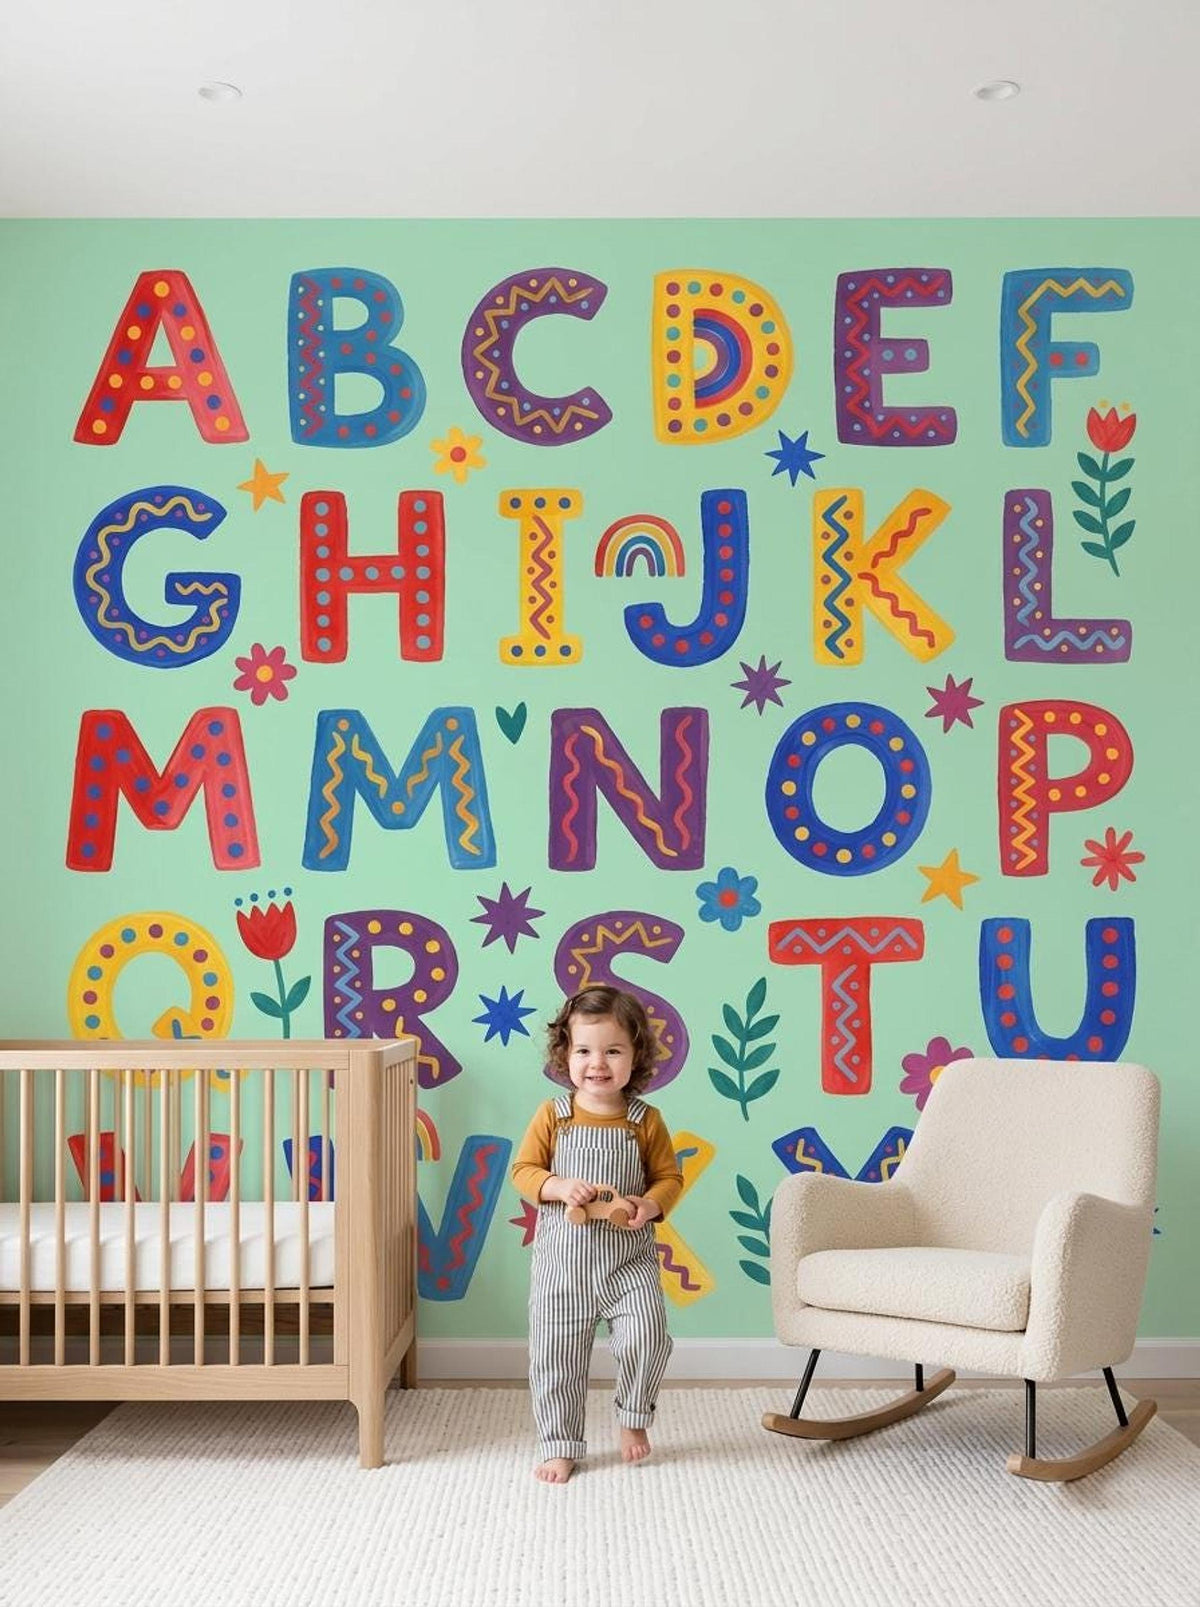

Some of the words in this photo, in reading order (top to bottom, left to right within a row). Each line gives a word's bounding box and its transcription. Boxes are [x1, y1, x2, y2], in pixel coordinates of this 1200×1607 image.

[74, 268, 249, 446] A
[287, 267, 426, 448] B
[461, 267, 613, 446] C
[651, 268, 795, 446] D
[834, 267, 957, 447] E
[1000, 268, 1135, 447] F
[72, 484, 242, 669] G
[299, 489, 446, 664] H
[498, 487, 584, 667] I
[624, 488, 751, 668] J
[812, 487, 955, 667] K
[1003, 488, 1133, 664] L
[65, 706, 261, 873] M
[302, 706, 497, 872] M
[548, 706, 709, 872] N
[765, 701, 932, 877] O
[997, 699, 1135, 877] P
[66, 911, 249, 1092] Q
[323, 909, 462, 1090] R
[543, 910, 691, 1095] S
[768, 916, 925, 1095] T
[979, 916, 1137, 1064] U
